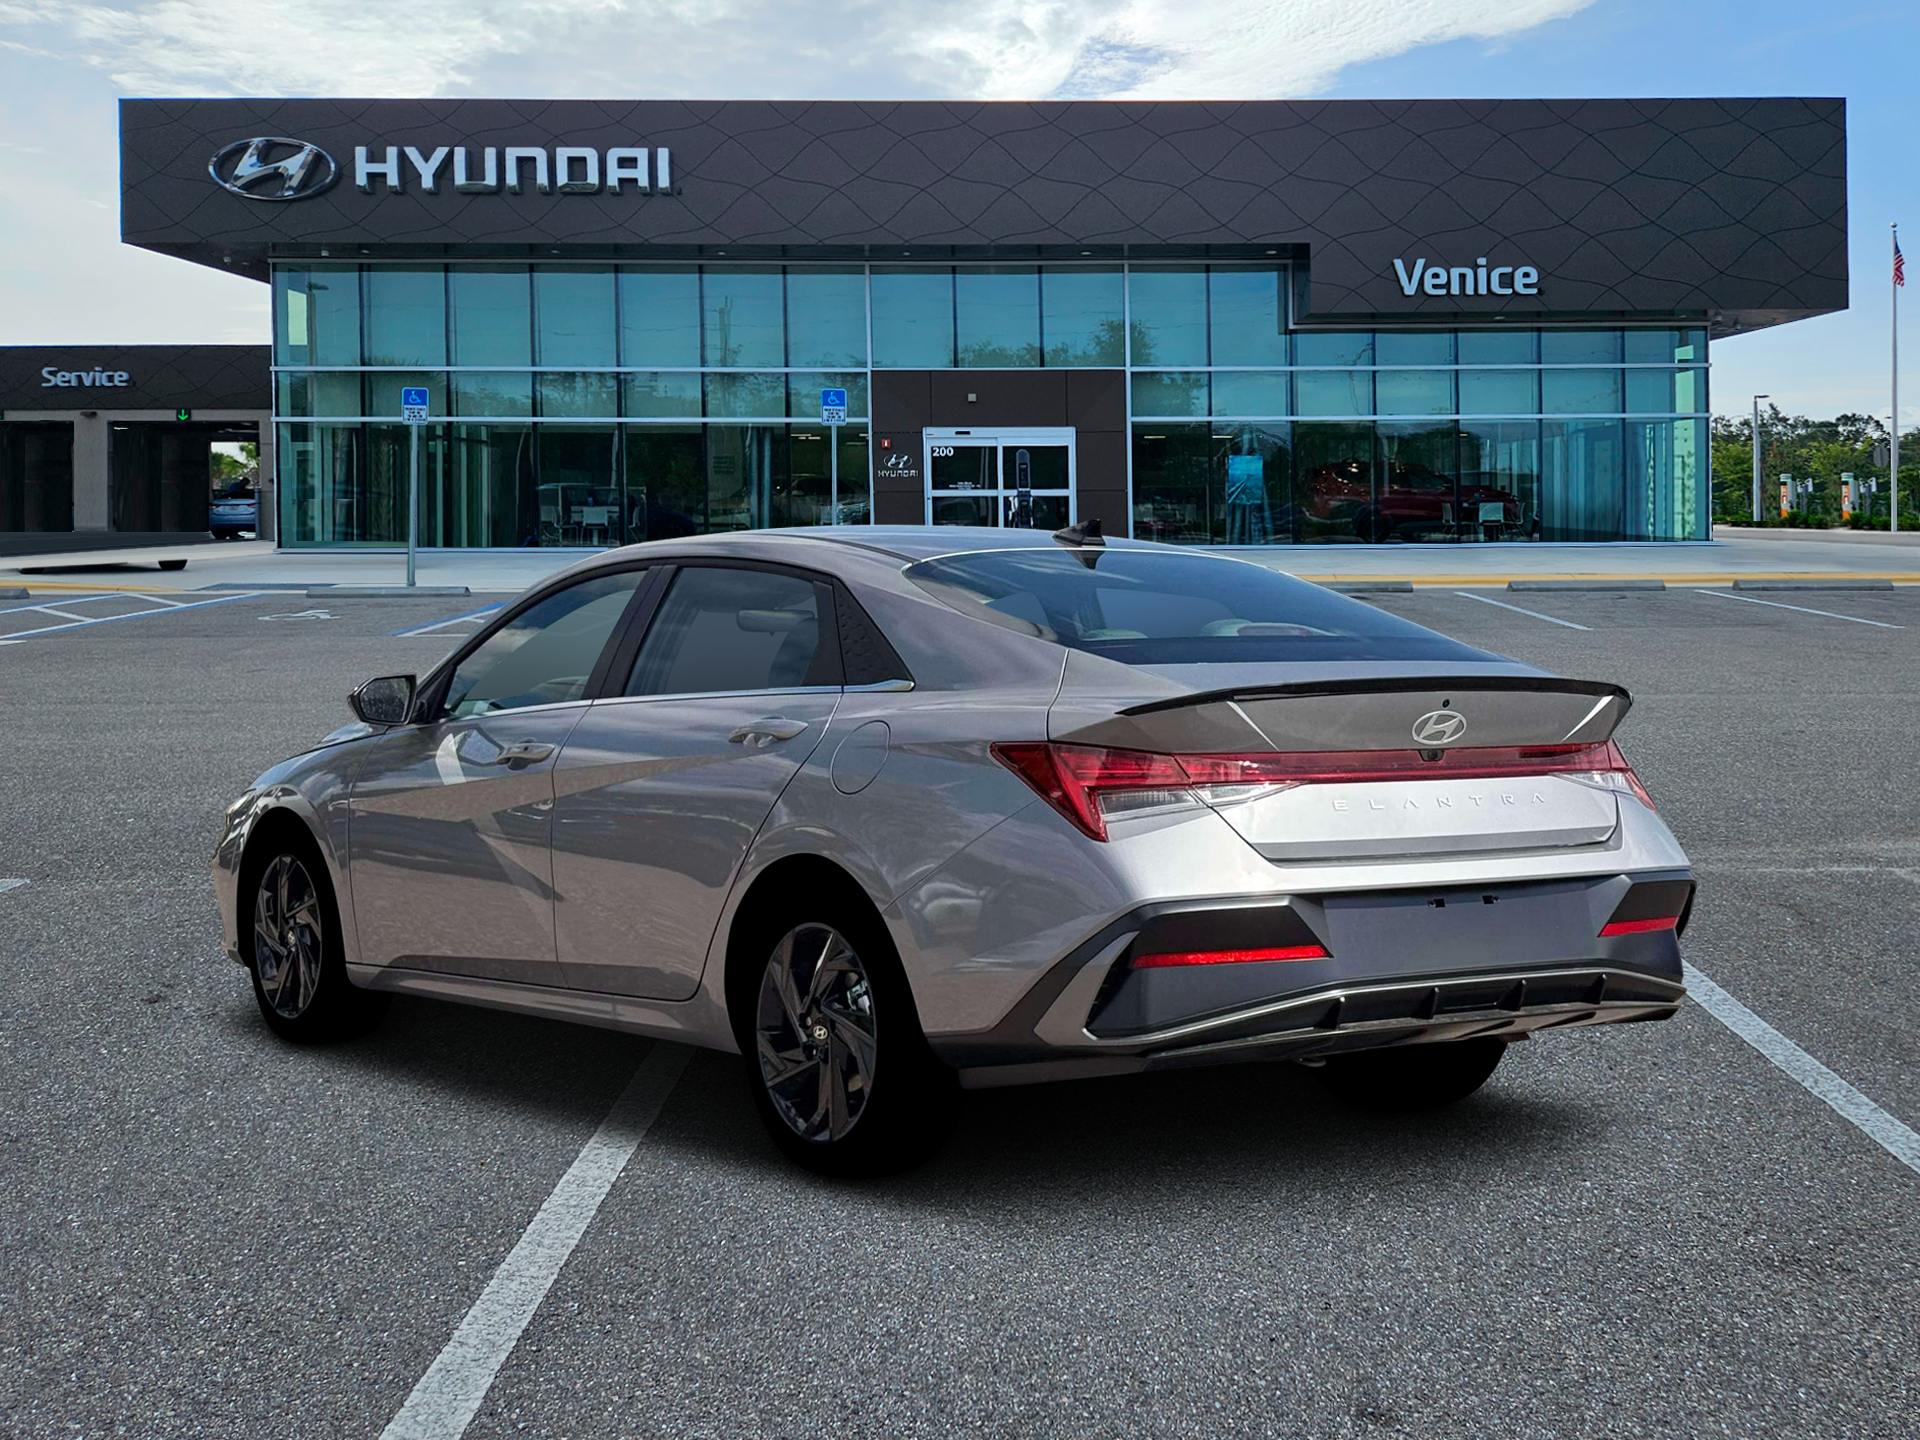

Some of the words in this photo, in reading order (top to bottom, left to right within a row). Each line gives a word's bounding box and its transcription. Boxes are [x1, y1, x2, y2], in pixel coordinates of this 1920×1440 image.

[355, 146, 671, 193] HYUNDAI
[1393, 257, 1538, 296] Venice
[41, 366, 130, 387] Service
[932, 446, 954, 457] 200
[877, 469, 919, 478] HYUNDAI
[1332, 792, 1546, 812] ELANTRA
